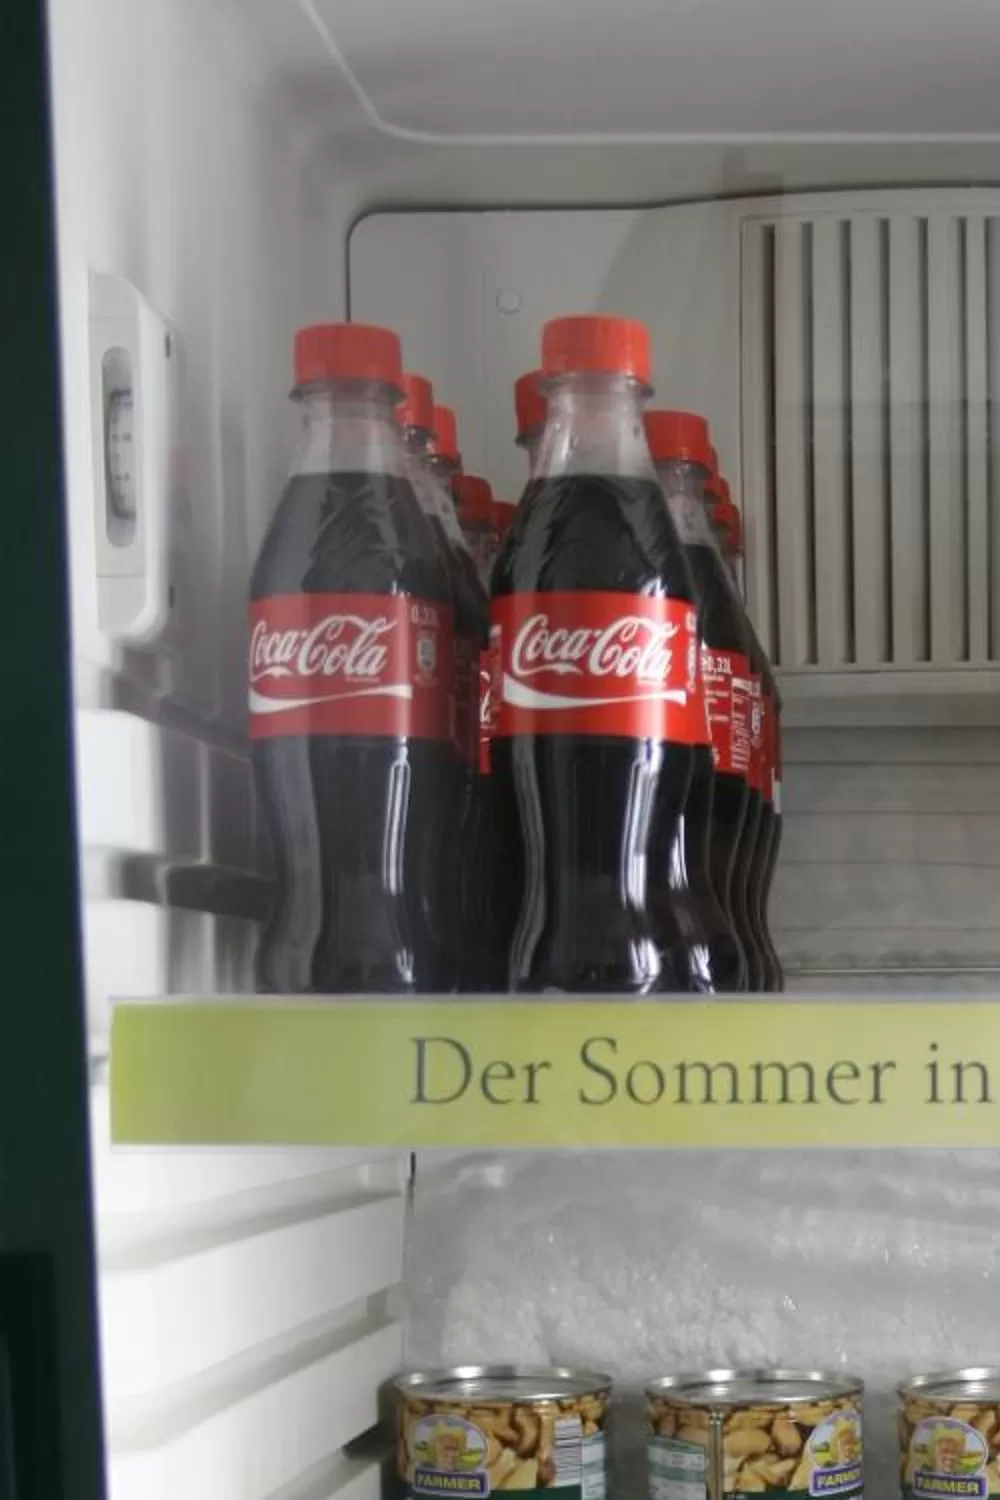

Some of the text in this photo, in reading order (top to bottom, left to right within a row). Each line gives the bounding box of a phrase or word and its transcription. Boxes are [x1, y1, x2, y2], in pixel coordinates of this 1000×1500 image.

[250, 615, 398, 682] Coca-Cola
[510, 612, 679, 678] Coca-Cola
[410, 1037, 551, 1105] Der
[579, 1037, 895, 1106] Sommer
[925, 1041, 992, 1104] in
[413, 1471, 482, 1492] FARMER
[915, 1475, 980, 1495] FARMER
